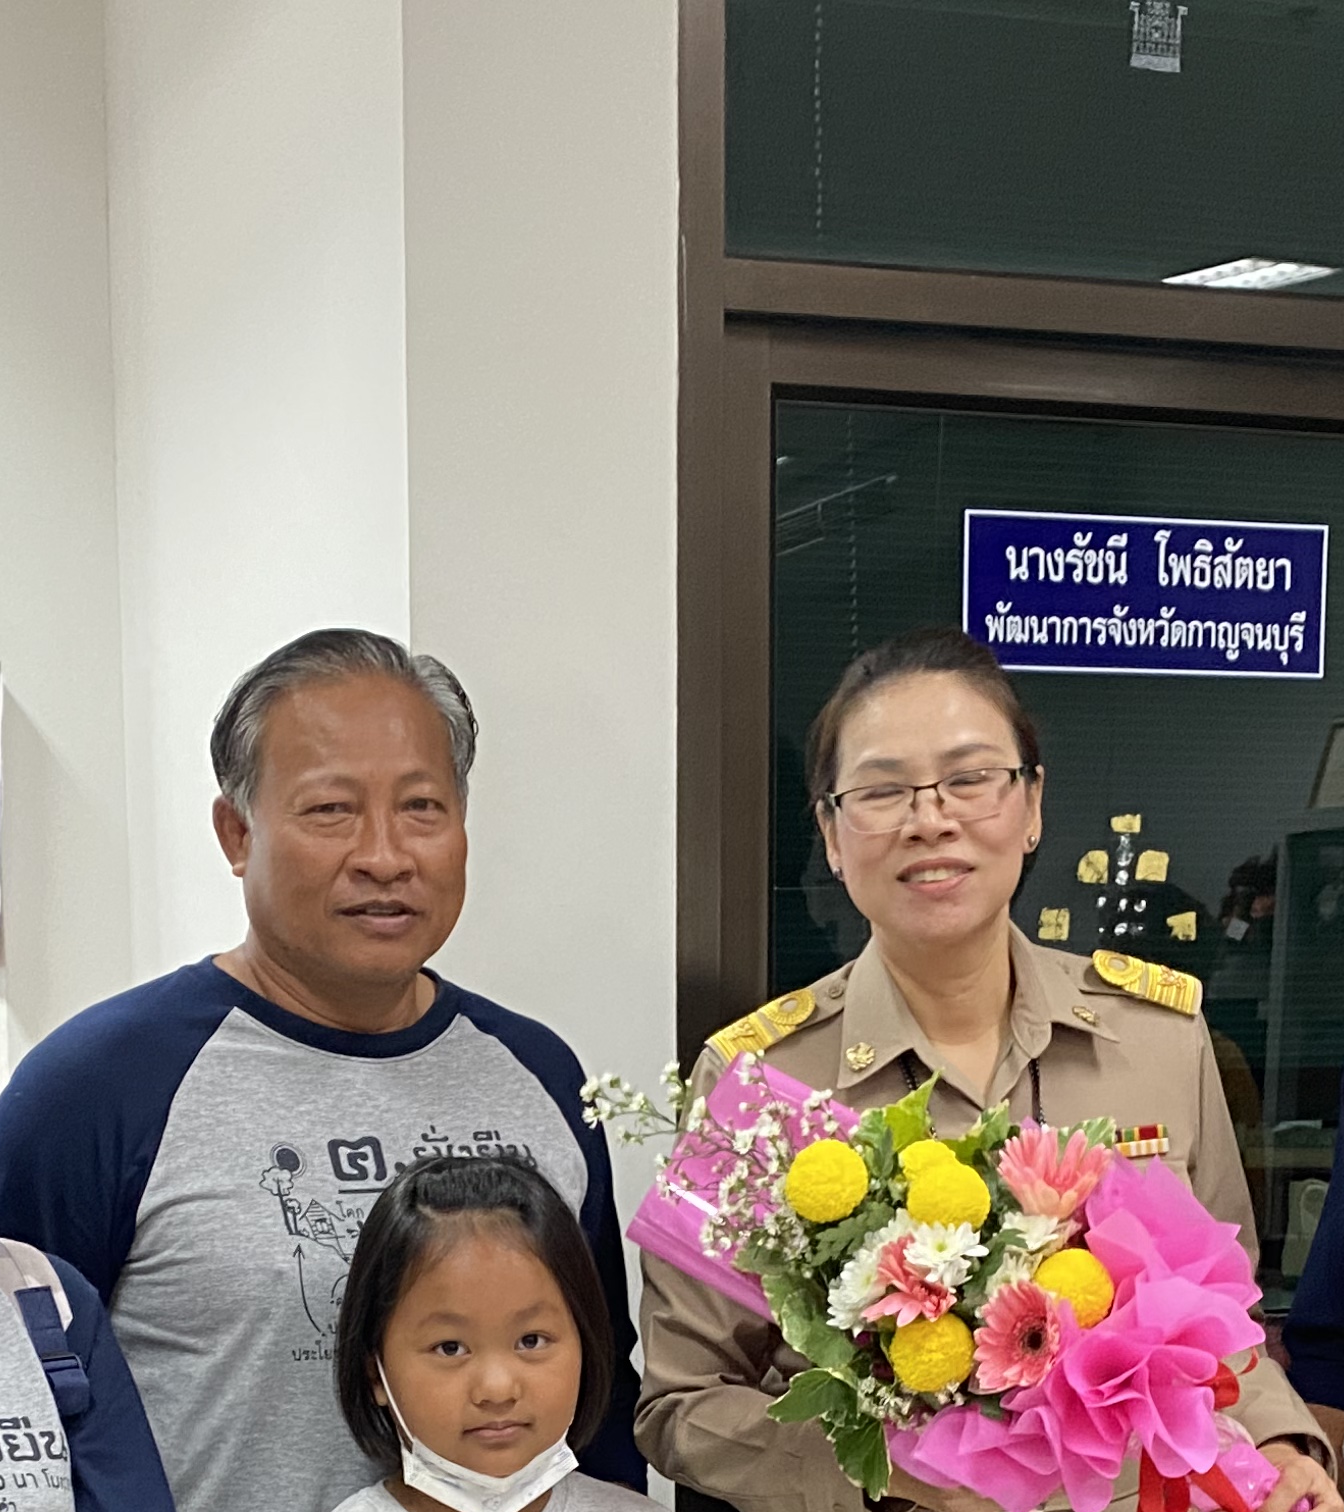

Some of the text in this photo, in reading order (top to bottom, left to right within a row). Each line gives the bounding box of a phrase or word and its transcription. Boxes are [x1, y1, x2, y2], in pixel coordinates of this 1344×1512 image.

[1005, 528, 1293, 592] นางรัชนี โพธิสัตยา
[985, 600, 1307, 666] พัฒนาการจังหวัดกาญจนบุรี
[336, 1200, 365, 1219] โคก
[12, 1472, 39, 1489] นา
